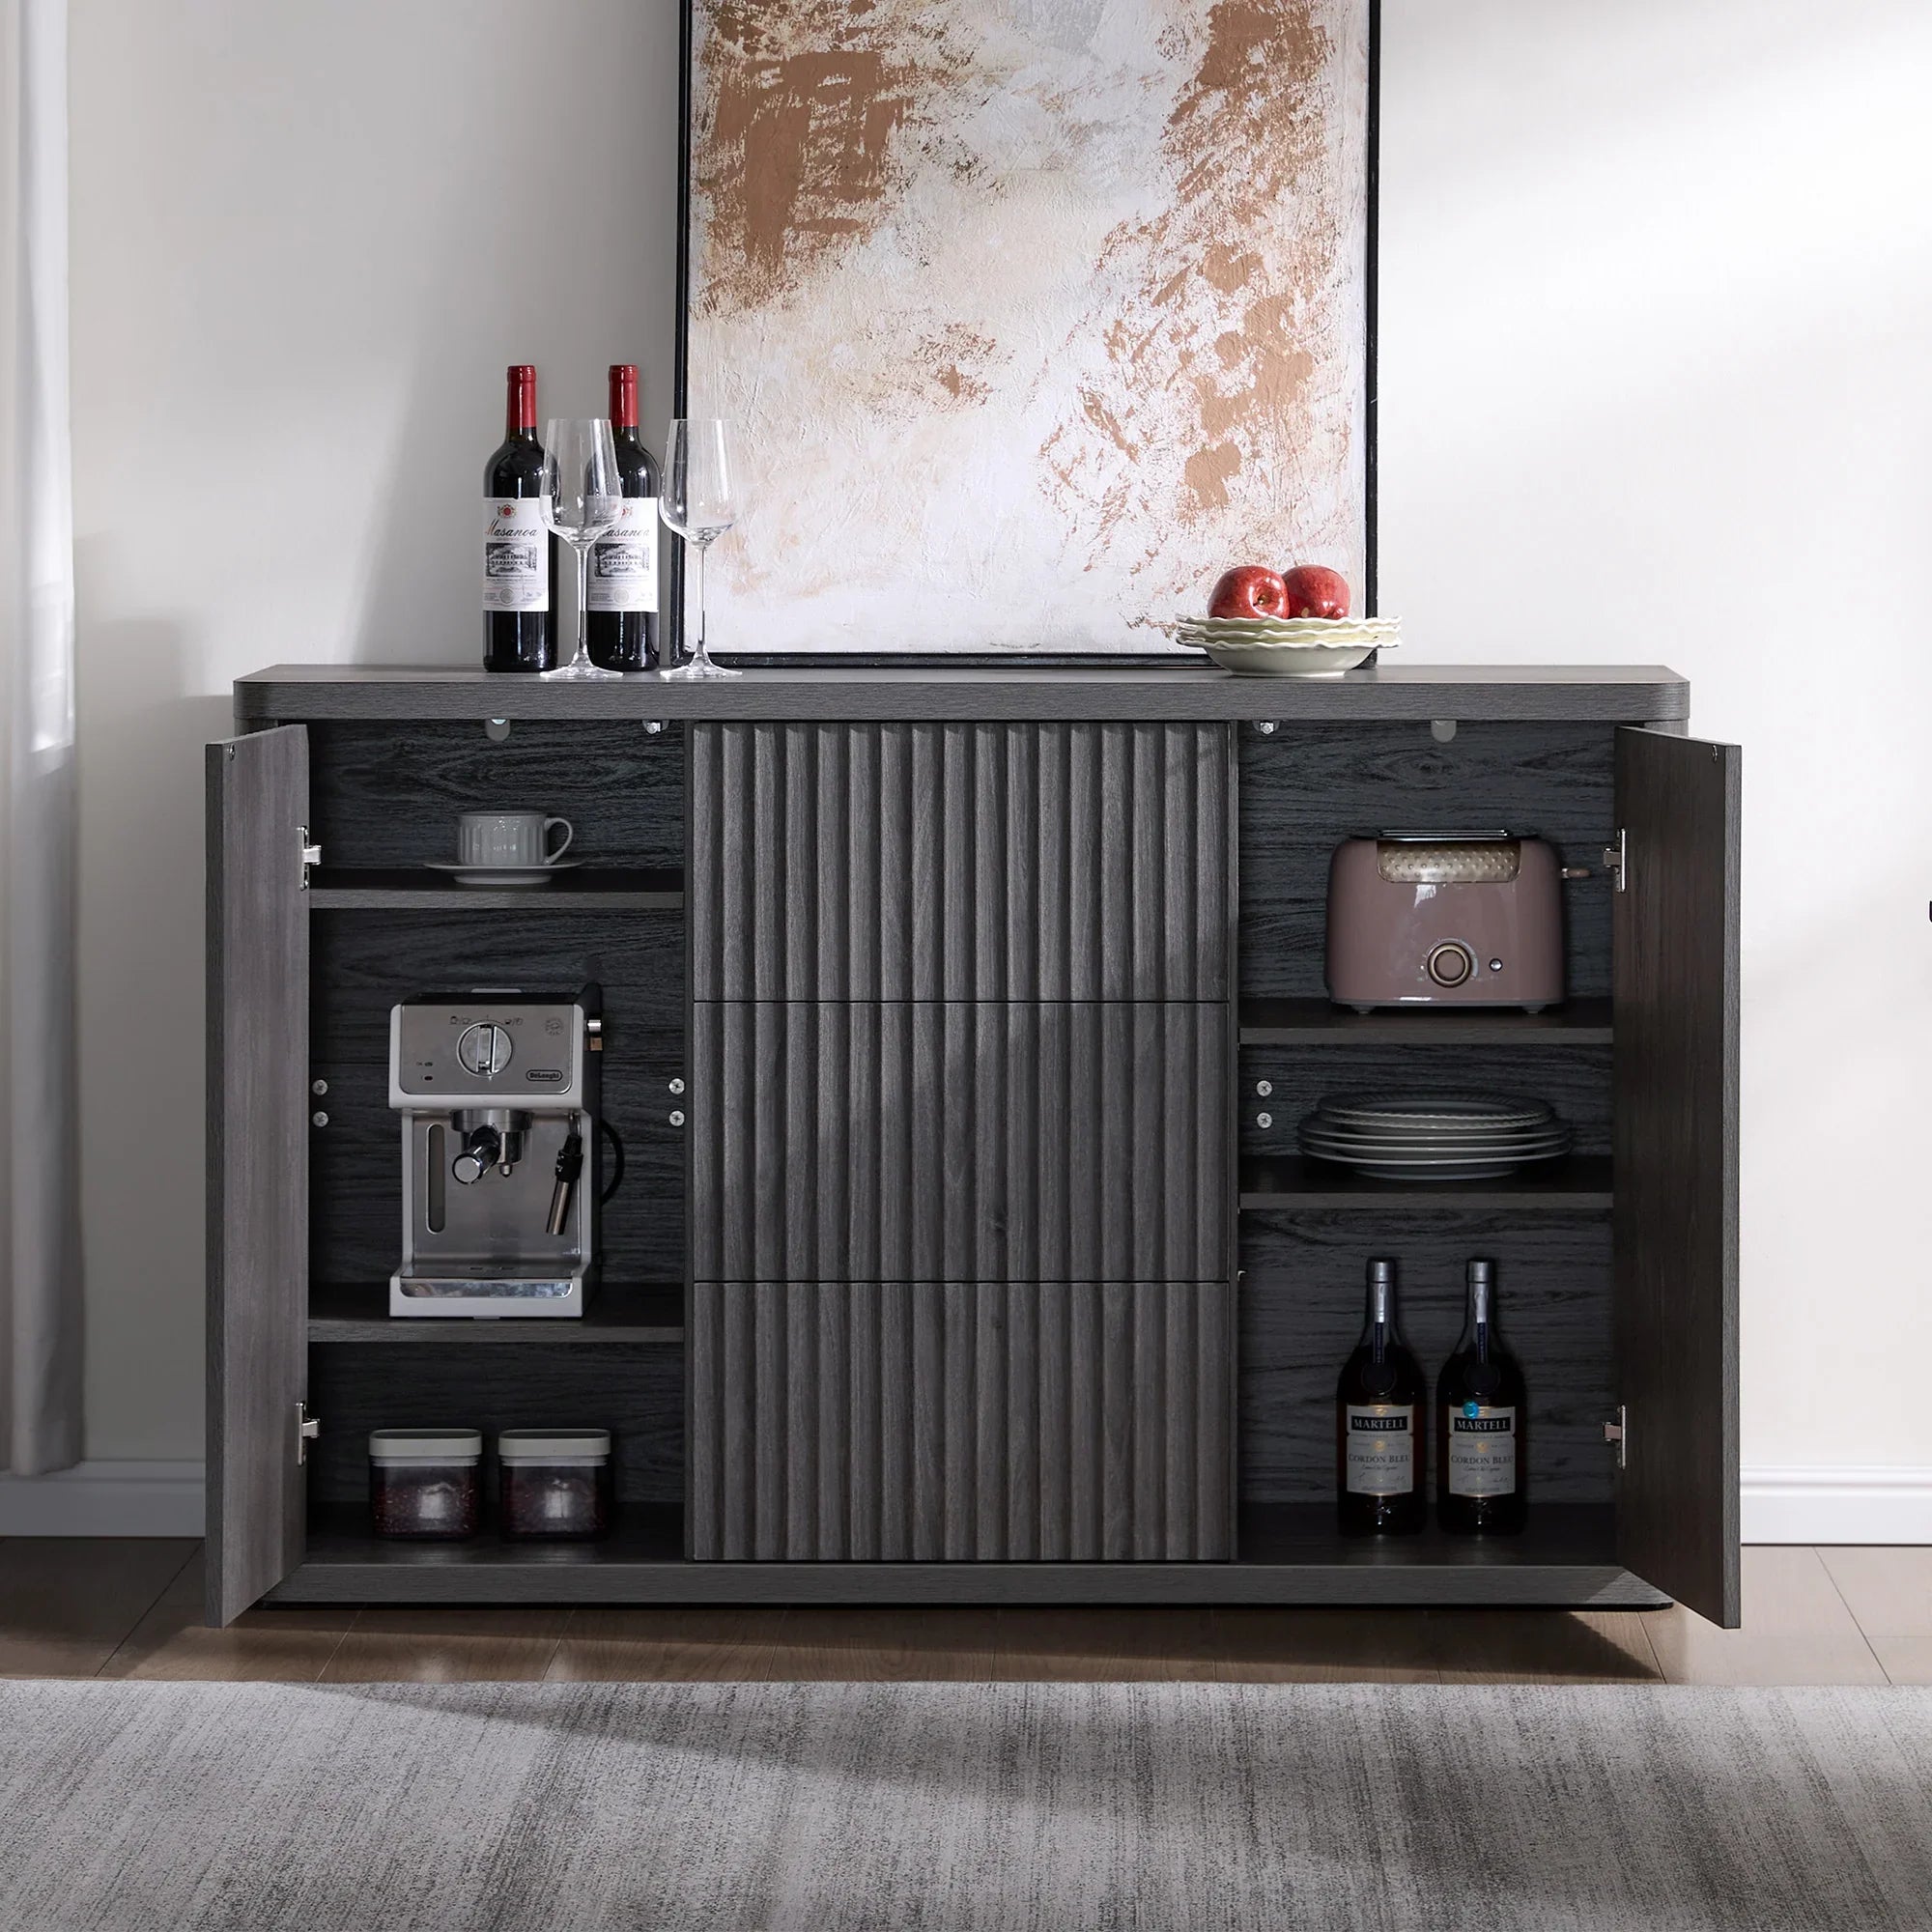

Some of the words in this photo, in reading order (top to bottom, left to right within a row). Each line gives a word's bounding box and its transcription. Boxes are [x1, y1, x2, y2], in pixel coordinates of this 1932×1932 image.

[1353, 1417, 1406, 1430] MARTELL
[1457, 1420, 1508, 1431] MARTELL
[1349, 1453, 1386, 1463] CORDON
[1389, 1454, 1410, 1463] BLEU
[1451, 1455, 1491, 1464] CORDON
